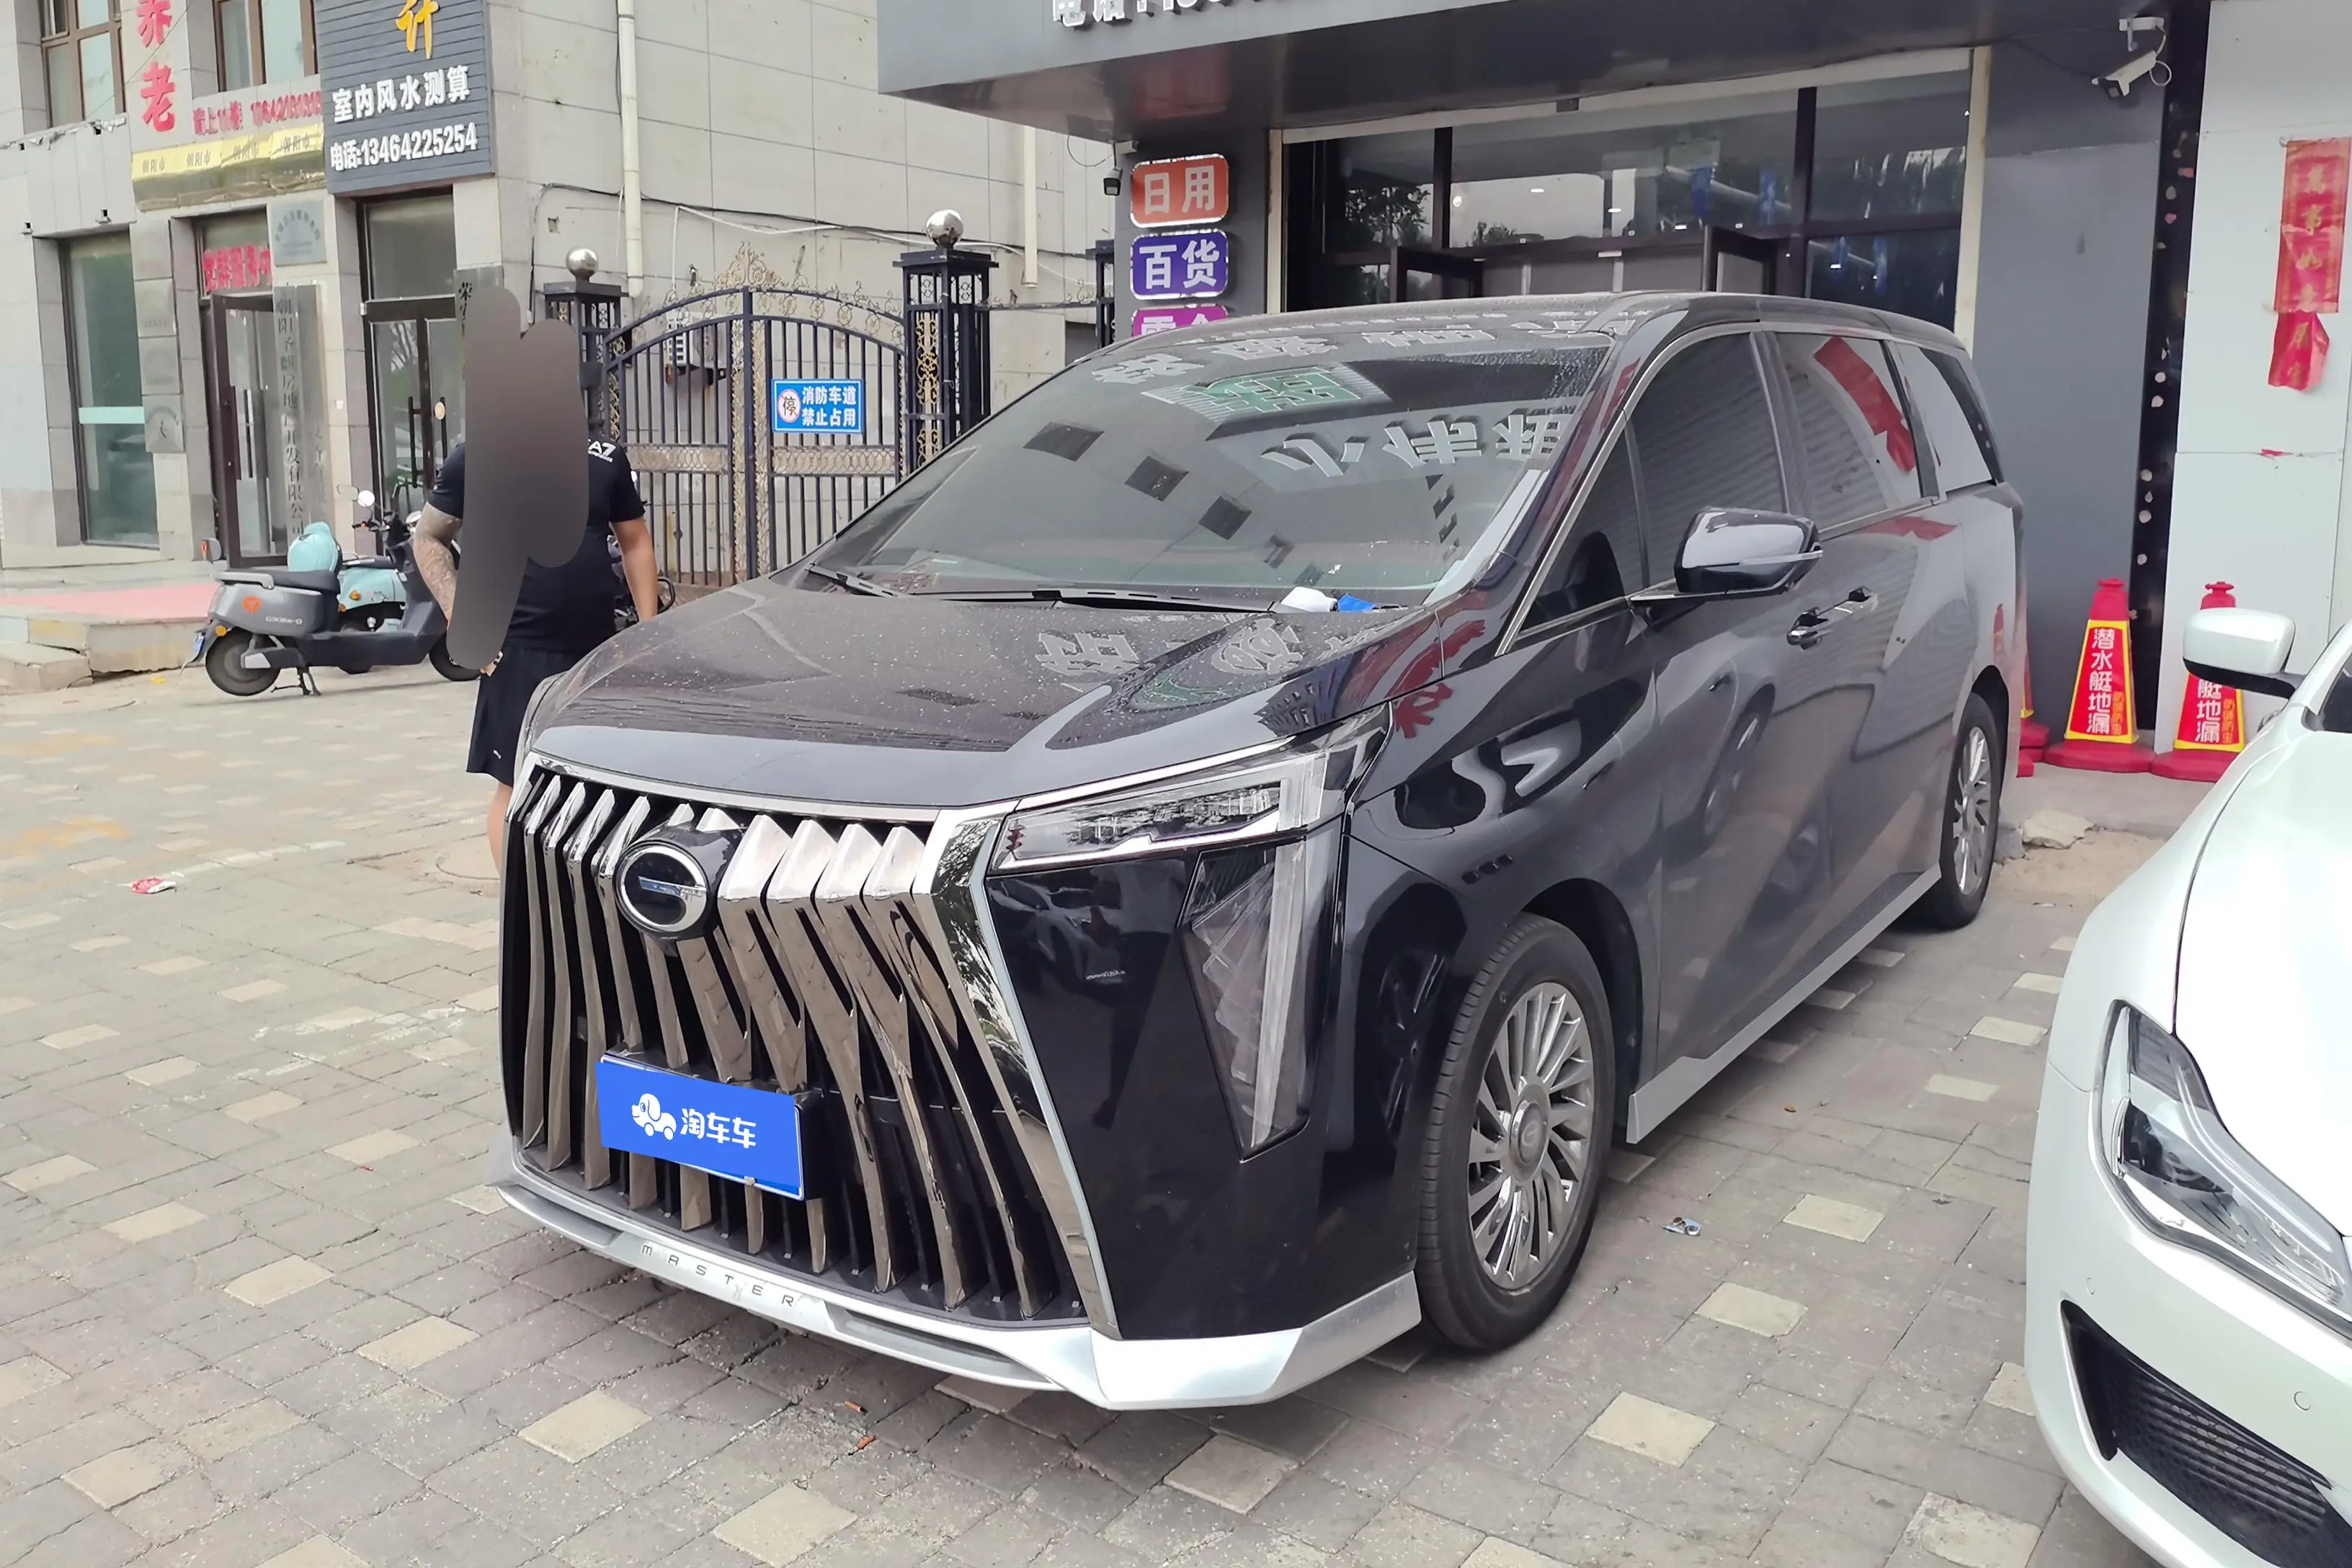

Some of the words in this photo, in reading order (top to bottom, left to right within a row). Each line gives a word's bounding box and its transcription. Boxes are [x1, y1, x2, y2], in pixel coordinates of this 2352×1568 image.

[331, 65, 471, 123] 室内风水测算
[330, 122, 478, 172] 电话:13464225254
[1144, 165, 1214, 215] 日用
[1139, 239, 1219, 289] 百货
[802, 386, 856, 405] 消防车道
[802, 407, 856, 427] 禁止占用
[587, 438, 616, 457] A7
[2087, 628, 2115, 735] 潜水艇地漏
[641, 1244, 794, 1309] MASTER
